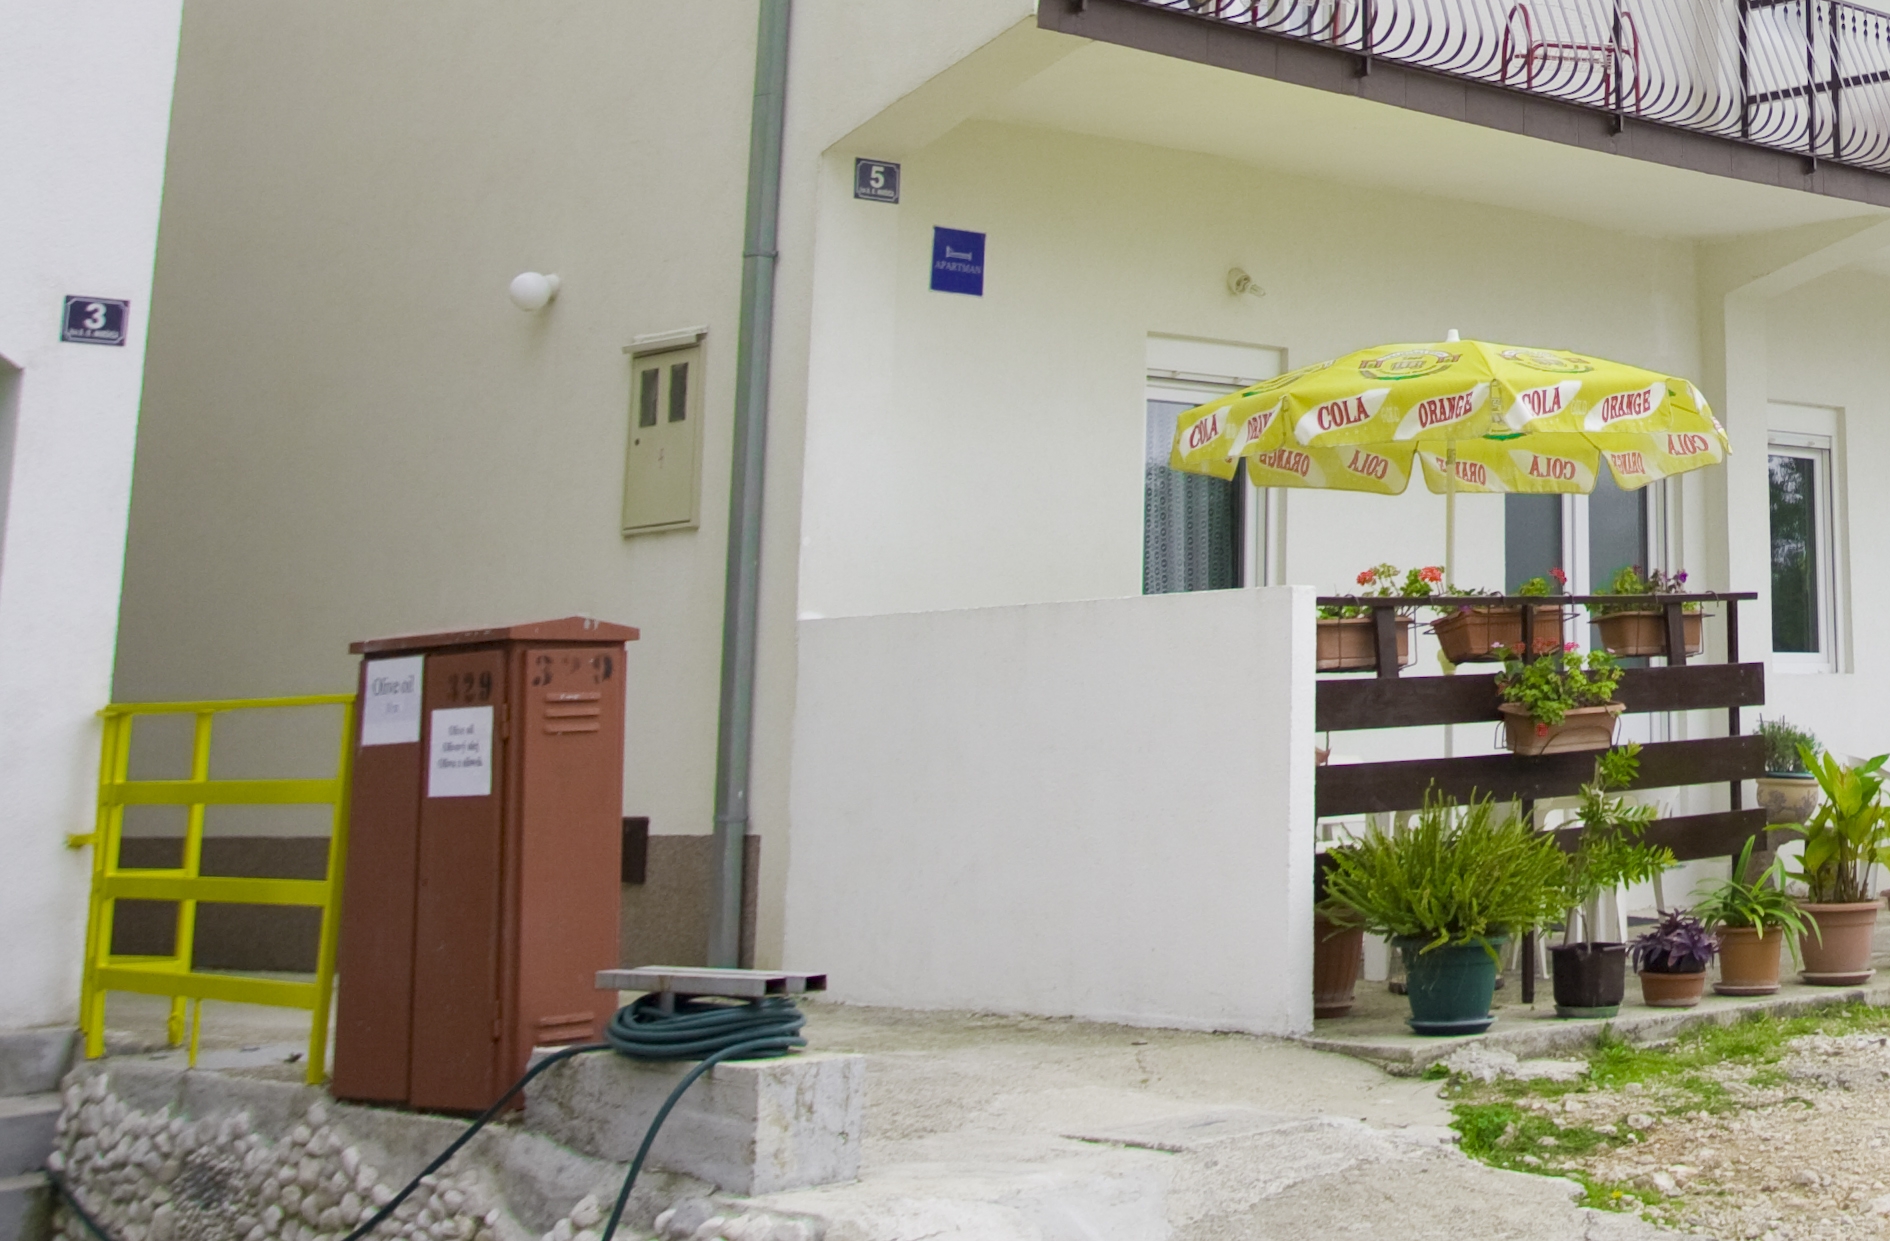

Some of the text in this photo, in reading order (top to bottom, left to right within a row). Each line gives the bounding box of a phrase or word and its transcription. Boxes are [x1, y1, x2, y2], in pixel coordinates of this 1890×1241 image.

[870, 166, 885, 189] 5
[84, 303, 107, 330] 3
[1318, 396, 1370, 430] COLA
[1418, 391, 1473, 428] ORANGE
[1522, 386, 1562, 417] COLA
[1601, 389, 1652, 423] ORANGE
[1189, 413, 1219, 449] COLA
